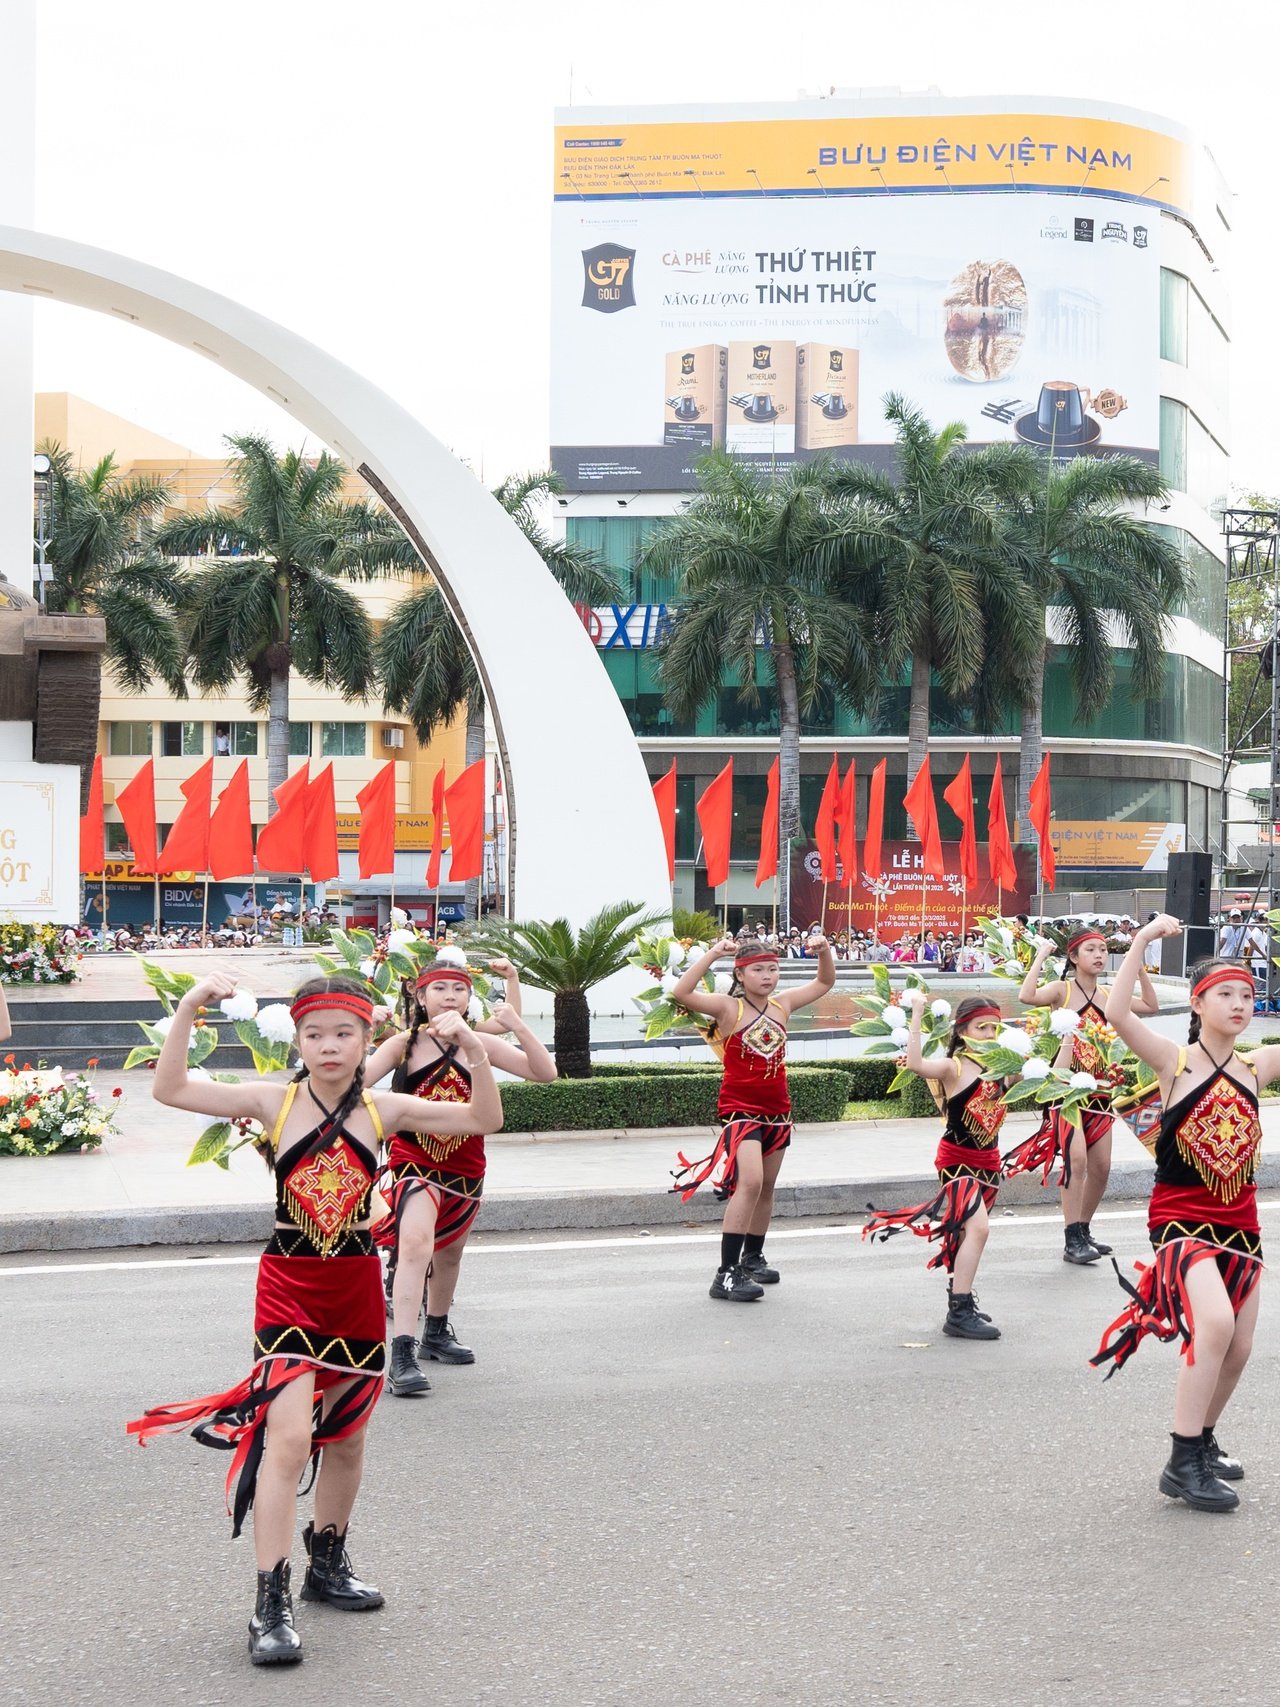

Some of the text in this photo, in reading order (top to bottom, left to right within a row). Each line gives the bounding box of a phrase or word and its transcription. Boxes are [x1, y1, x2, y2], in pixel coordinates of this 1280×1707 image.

[819, 144, 887, 165] BƯU
[987, 136, 1058, 166] VIỆT
[1066, 145, 1132, 171] NAM
[662, 248, 712, 266] CÀ PHÊ
[718, 250, 746, 262] NĂNG
[755, 246, 876, 275] THỨ THIỆT
[598, 288, 620, 300] GOLD
[662, 278, 877, 308] NĂNG LƯỢNG TỈNH THỨC
[1102, 398, 1116, 409] NEW
[1052, 830, 1083, 841] ĐIỆN
[892, 849, 910, 868] LỄ
[888, 872, 903, 881] PHÊ
[904, 872, 923, 882] BUÔN
[164, 890, 192, 902] BIDV
[438, 906, 455, 915] ACB
[828, 902, 849, 910] Buôn
[851, 902, 864, 910] Ma
[947, 904, 956, 912] cà
